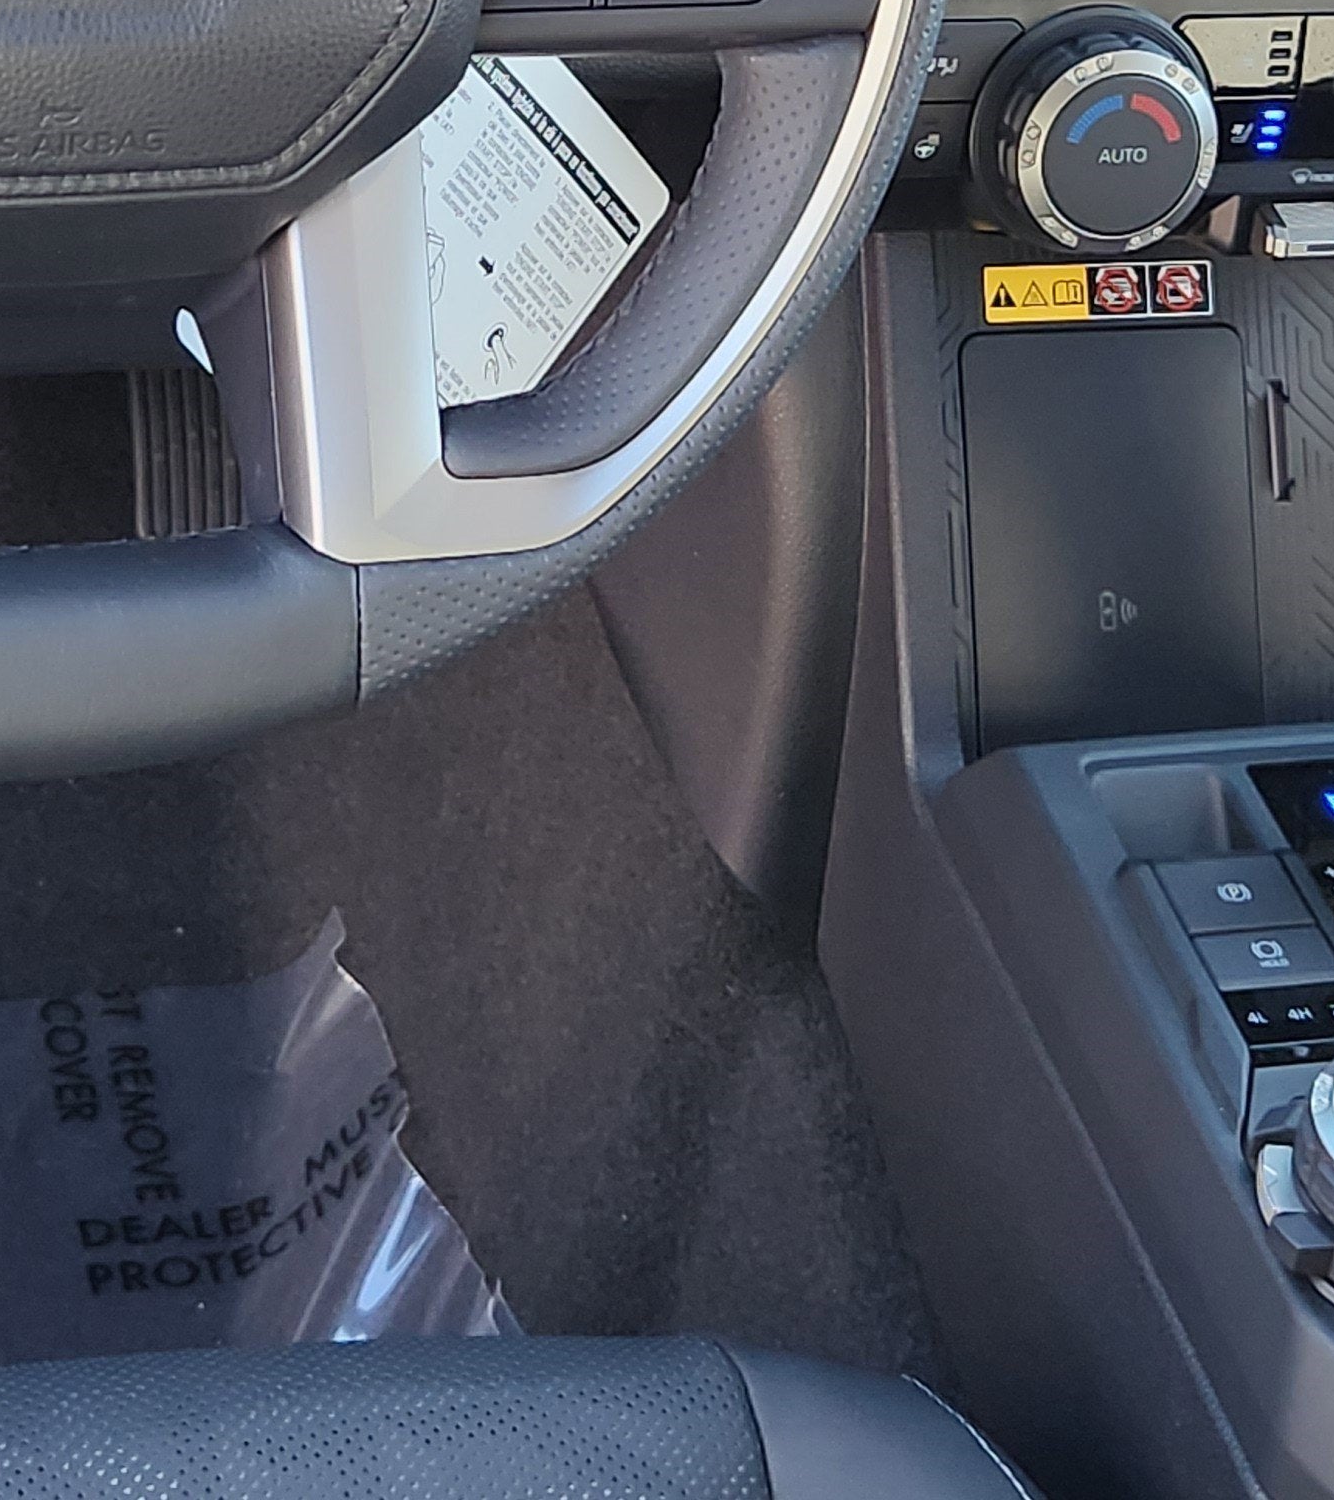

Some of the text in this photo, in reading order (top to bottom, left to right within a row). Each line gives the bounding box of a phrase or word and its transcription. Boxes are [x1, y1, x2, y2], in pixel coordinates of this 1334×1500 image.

[1098, 147, 1148, 165] AUTO
[1247, 1011, 1269, 1025] 4L
[1287, 1007, 1314, 1021] 4H
[40, 998, 100, 1123] COVER
[107, 1044, 181, 1204] REMOVE
[77, 1195, 274, 1248] DEALER
[87, 1148, 372, 1296] PROTECTIVE
